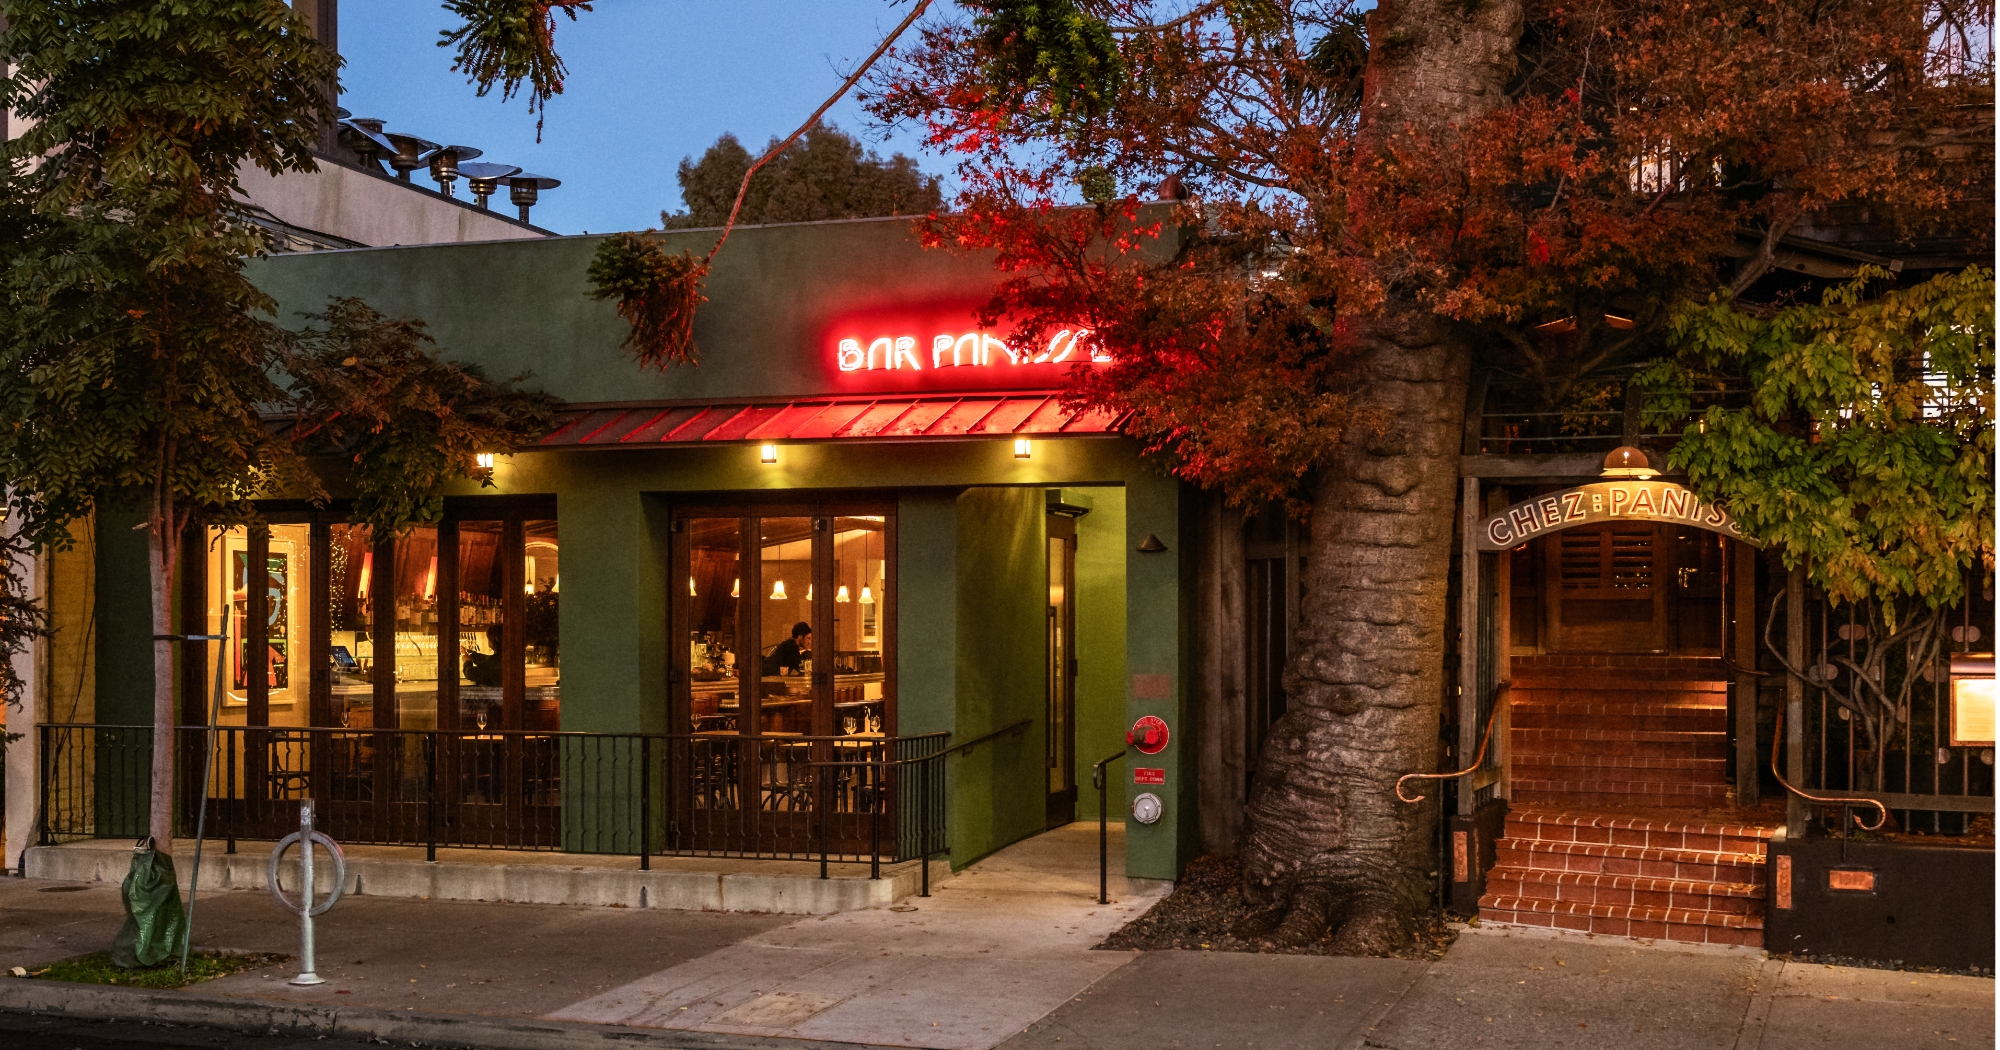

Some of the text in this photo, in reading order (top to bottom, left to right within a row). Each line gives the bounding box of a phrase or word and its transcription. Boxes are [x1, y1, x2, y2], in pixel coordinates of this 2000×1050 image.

[838, 336, 921, 372] BAR
[1487, 491, 1586, 546] CHEZ
[1608, 487, 1761, 542] PANIS
